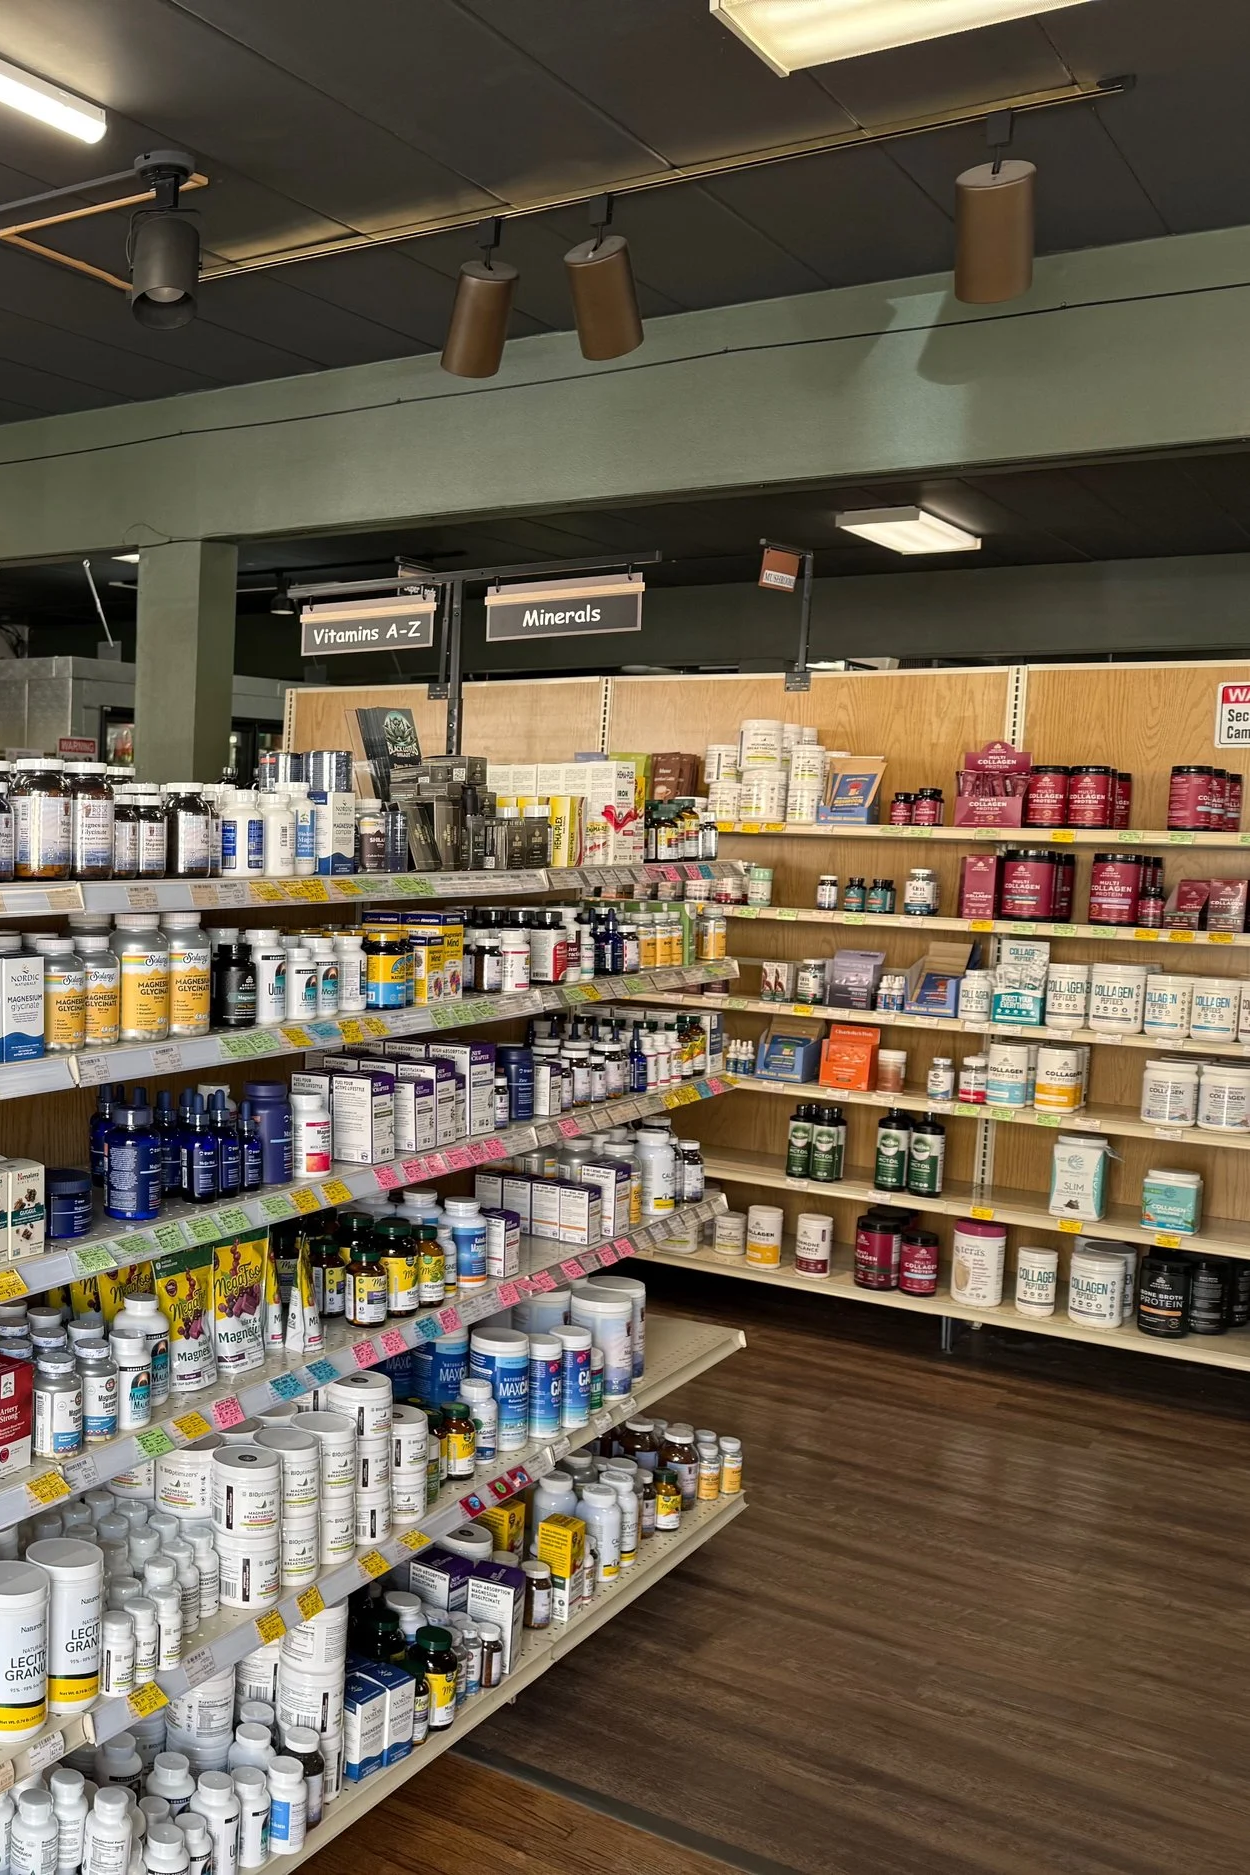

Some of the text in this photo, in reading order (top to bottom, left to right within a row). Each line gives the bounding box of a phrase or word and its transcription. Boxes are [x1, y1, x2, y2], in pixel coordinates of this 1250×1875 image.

[522, 605, 601, 627] Minerals
[313, 620, 421, 645] Vitamins A-Z
[61, 740, 95, 752] WARNING
[553, 816, 563, 850] HEMA-PLEX
[1091, 885, 1132, 893] COLLAGEN
[11, 972, 39, 983] NORDIC
[1095, 984, 1134, 998] COLLAGEN
[8, 994, 42, 1003] MAGNESIUM
[1101, 996, 1124, 1005] PEPTIDES
[11, 1001, 40, 1012] glycinate
[1064, 1181, 1085, 1191] SLIM
[19, 1208, 37, 1216] GUGGUL
[1025, 1281, 1049, 1291] PEPTIDES
[1072, 1276, 1108, 1295] COLLAGEN
[1076, 1291, 1098, 1302] PEPTIDES
[1141, 1289, 1160, 1299] BONE
[1141, 1295, 1183, 1308] PROTEIN
[0, 1405, 18, 1417] Artery
[0, 1411, 18, 1423] Strong
[160, 1492, 193, 1500] BREAKTHROUGH
[413, 1566, 447, 1582] HIGH ABSORPTION
[412, 1577, 438, 1590] BISGLYCINATE
[471, 1582, 511, 1595] HIGH ABSORPTION
[471, 1588, 497, 1598] MAGNESIUM
[471, 1593, 500, 1604] BISGLYCINATE
